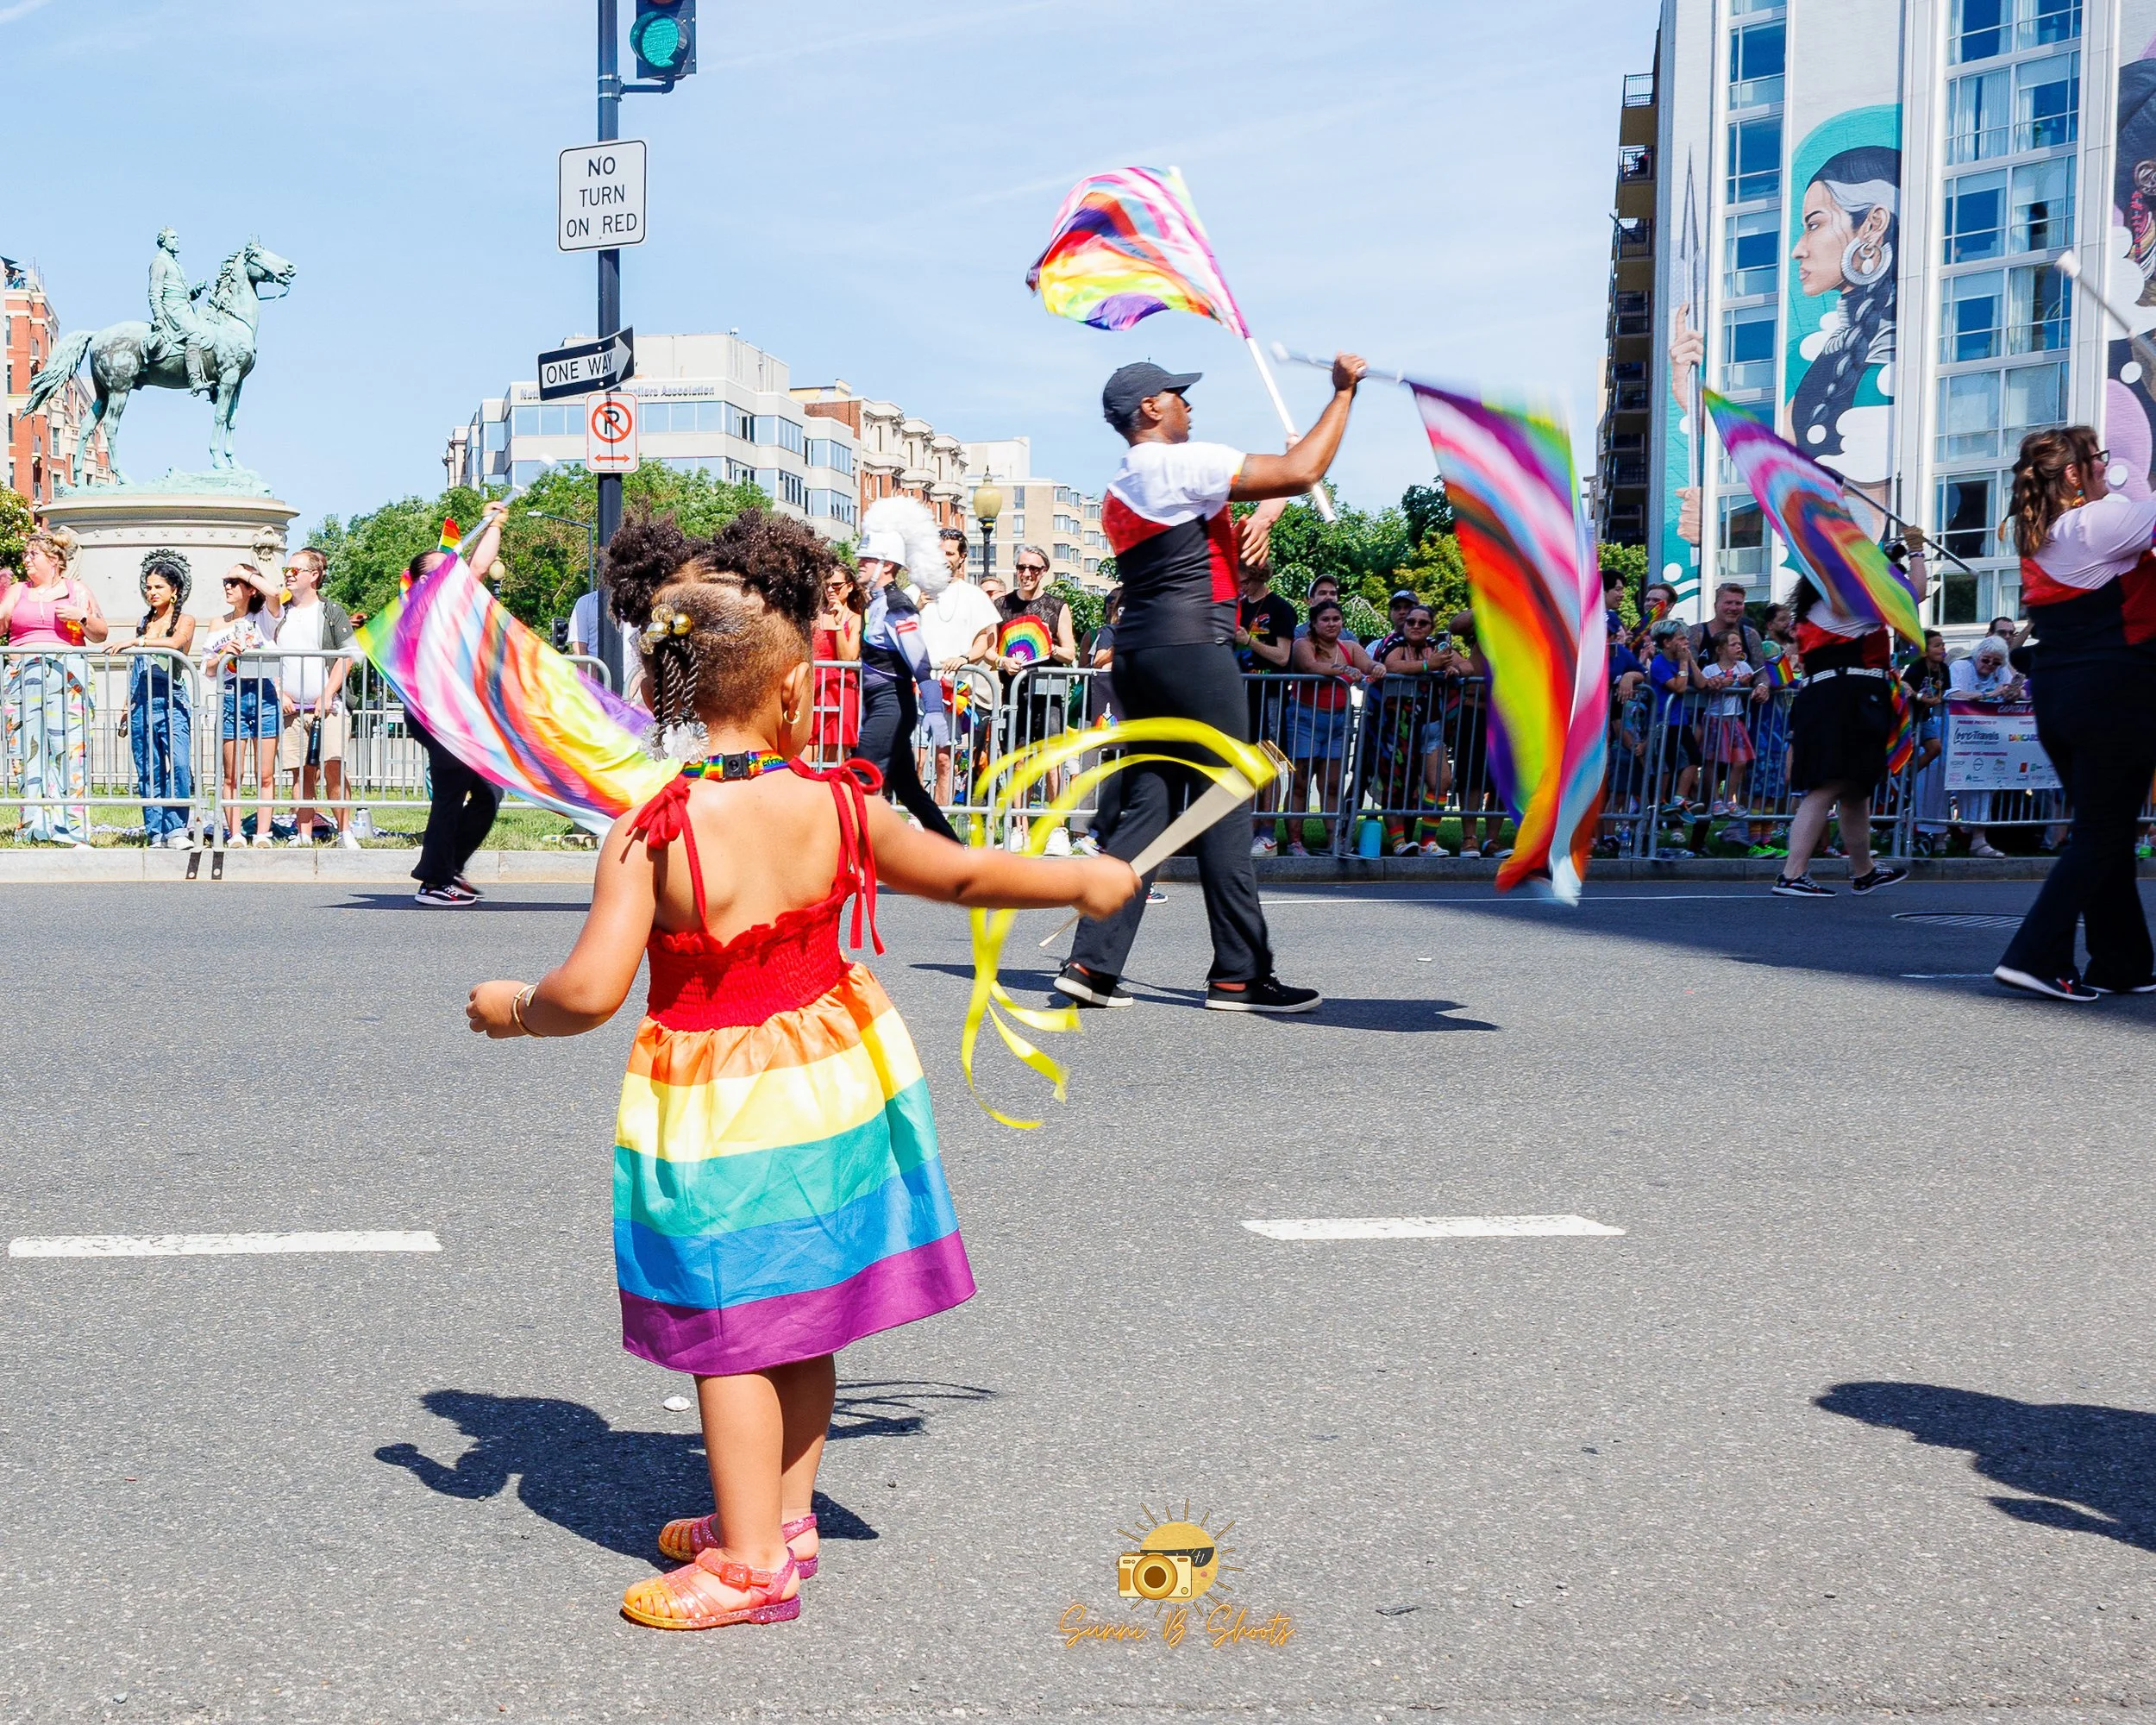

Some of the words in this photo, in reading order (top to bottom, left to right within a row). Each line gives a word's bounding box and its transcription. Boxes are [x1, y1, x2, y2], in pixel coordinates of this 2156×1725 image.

[588, 156, 616, 177] NO
[580, 184, 624, 207] TURN
[567, 217, 589, 237] ON
[603, 213, 636, 234] RED
[547, 361, 580, 384] ONE
[588, 352, 613, 376] WAY
